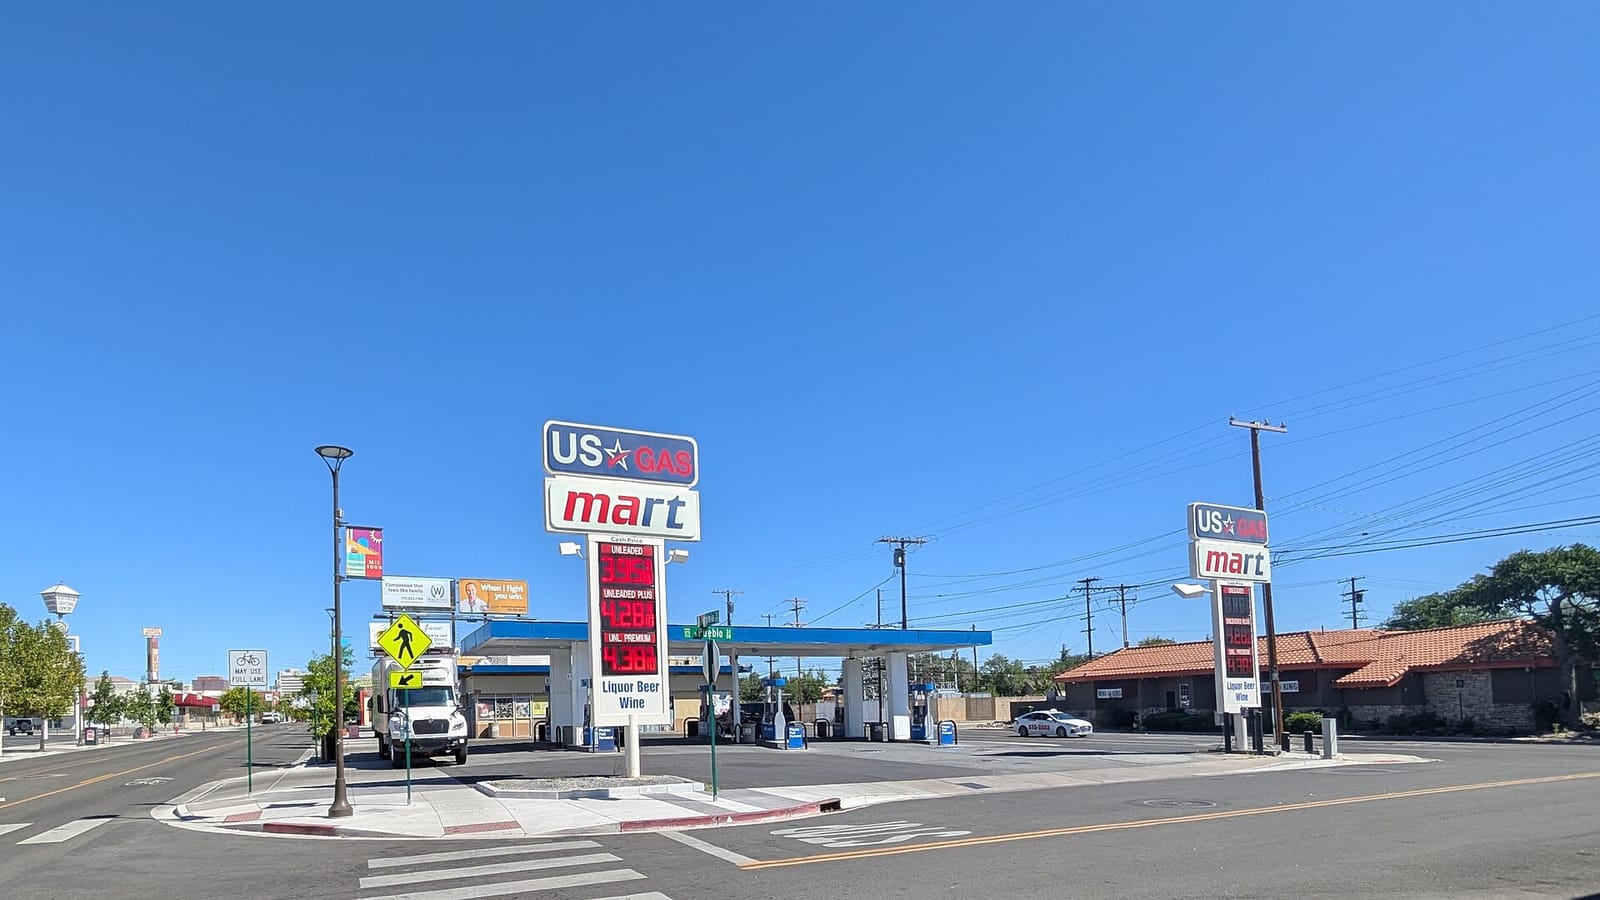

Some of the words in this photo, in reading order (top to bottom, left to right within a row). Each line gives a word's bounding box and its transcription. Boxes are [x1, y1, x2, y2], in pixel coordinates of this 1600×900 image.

[552, 431, 603, 467] US
[634, 446, 692, 477] GAS
[563, 491, 686, 530] mart
[1198, 509, 1222, 534] US
[1237, 517, 1266, 539] GAS
[611, 545, 643, 555] UNLEADED
[1206, 550, 1264, 576] mart
[506, 584, 524, 593] fight
[604, 589, 636, 599] UNLEADED
[637, 590, 653, 599] PLUS
[623, 633, 651, 643] PREMIUM
[698, 627, 723, 638] Pueblo
[602, 680, 634, 694] Liquor
[637, 680, 660, 692] Beer
[1227, 681, 1243, 691] Liquor
[1243, 681, 1255, 690] Beer
[1235, 692, 1249, 701] Wine
[619, 696, 645, 709] Wine
